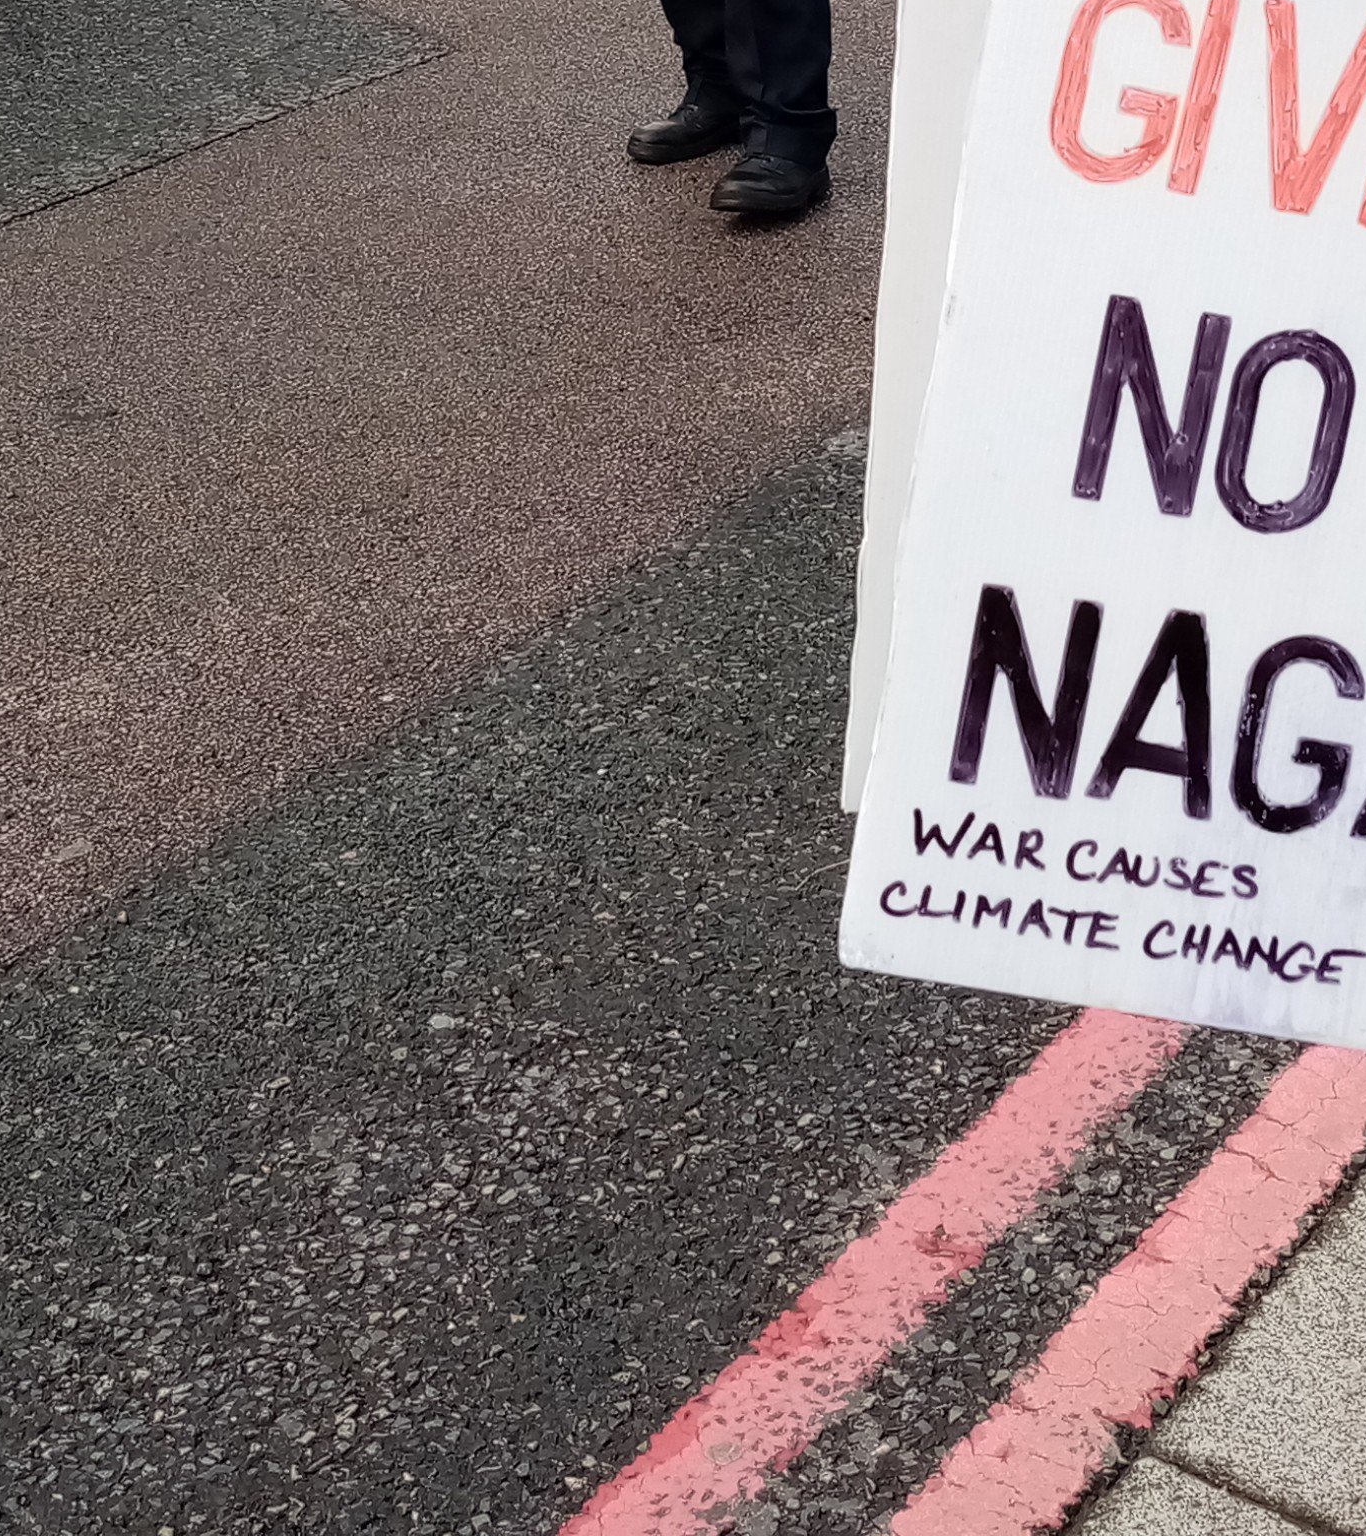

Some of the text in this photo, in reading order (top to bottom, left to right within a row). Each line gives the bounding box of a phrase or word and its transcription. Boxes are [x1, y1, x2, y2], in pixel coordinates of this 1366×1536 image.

[1072, 295, 1357, 535] NO
[913, 807, 1260, 900] WAR CAUSES
[879, 880, 1121, 952] CLIMATE
